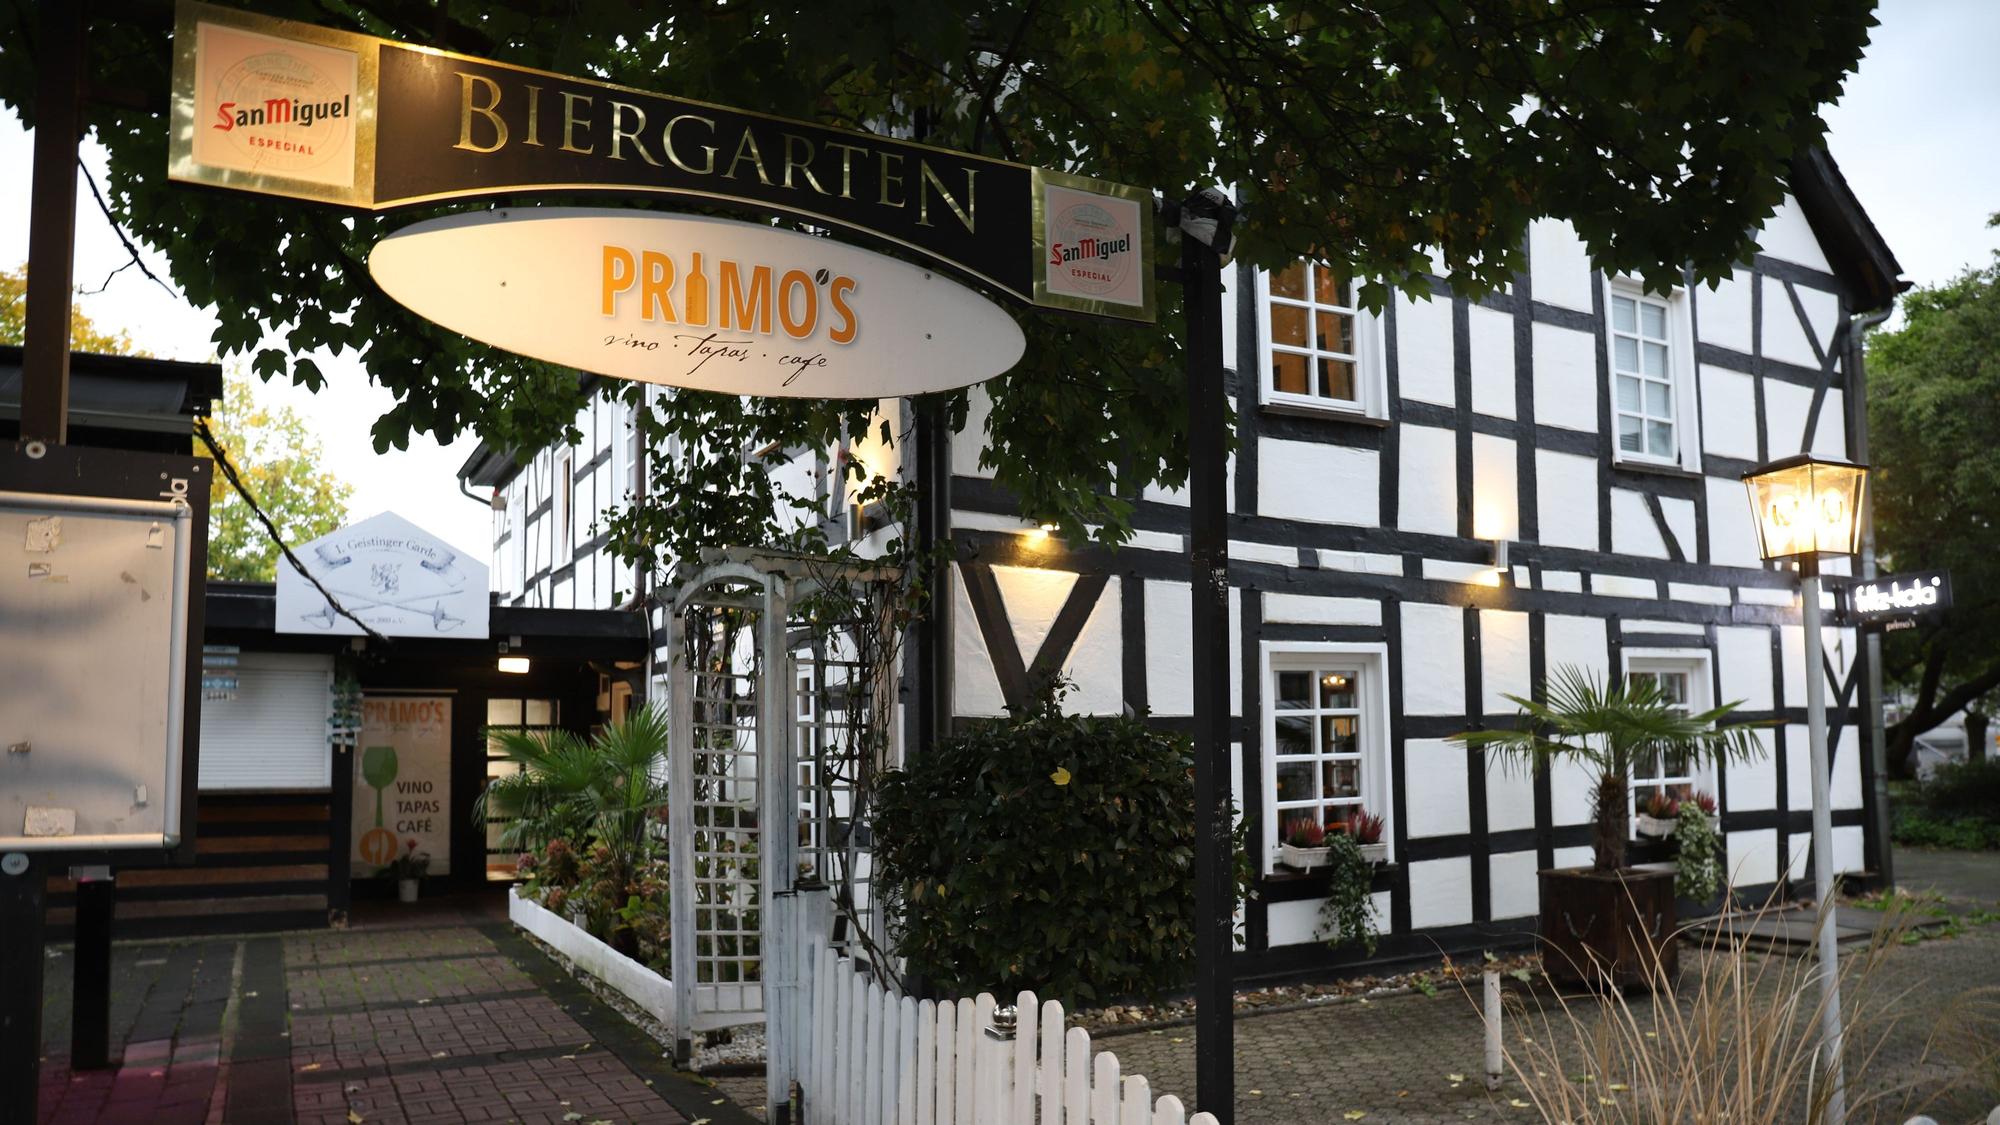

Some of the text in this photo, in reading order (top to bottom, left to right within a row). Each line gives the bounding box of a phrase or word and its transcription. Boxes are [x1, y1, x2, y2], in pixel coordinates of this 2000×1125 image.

[249, 136, 314, 155] ESPECIAL
[452, 71, 980, 235] BIERGARTEN
[1071, 268, 1112, 283] ESPECIAL
[600, 244, 859, 346] PRIMO'S
[604, 333, 660, 351] vino
[348, 536, 404, 549] Geistinger
[406, 540, 437, 559] Garde
[396, 780, 433, 794] VINO
[396, 800, 440, 814] TAPAS
[396, 817, 432, 833] CAFÉ
